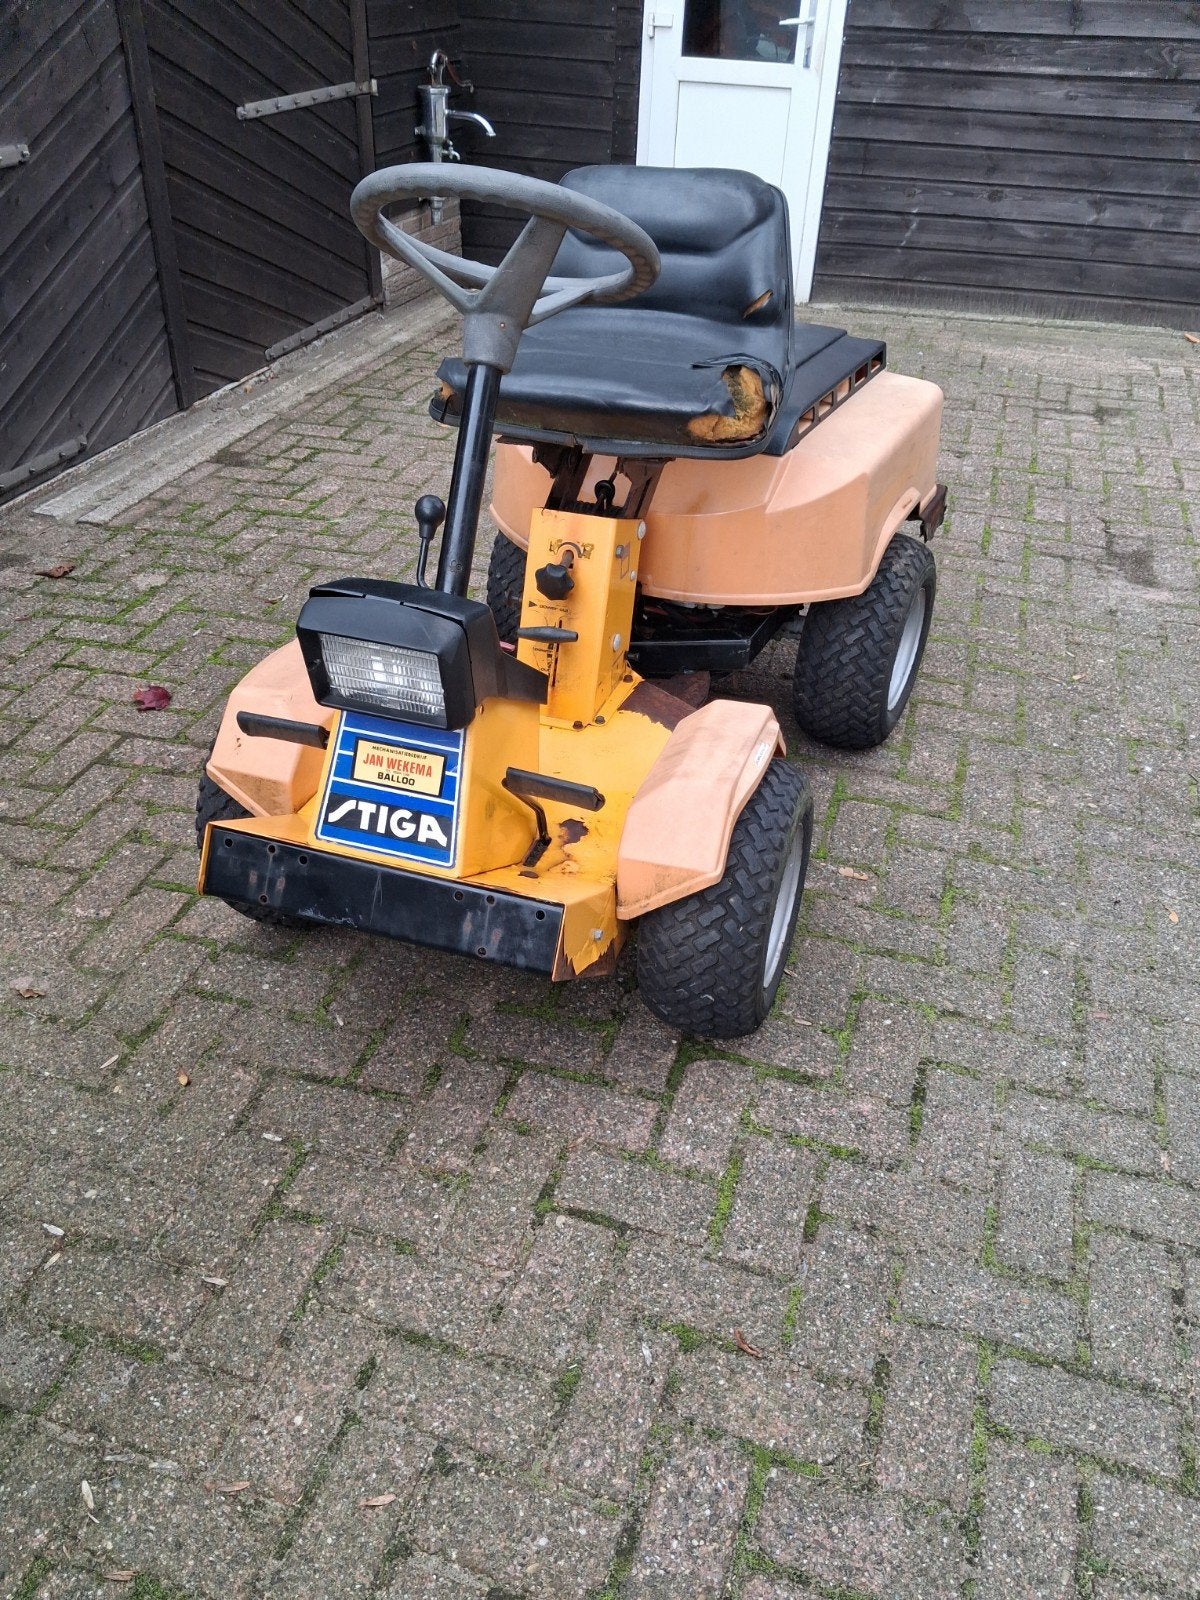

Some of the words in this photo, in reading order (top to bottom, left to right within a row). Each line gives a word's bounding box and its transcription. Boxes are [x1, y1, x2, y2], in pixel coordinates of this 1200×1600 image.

[363, 752, 384, 768] JAN
[386, 757, 432, 778] WEKEMA
[377, 771, 416, 786] BALLOO
[328, 799, 448, 848] STIGA
